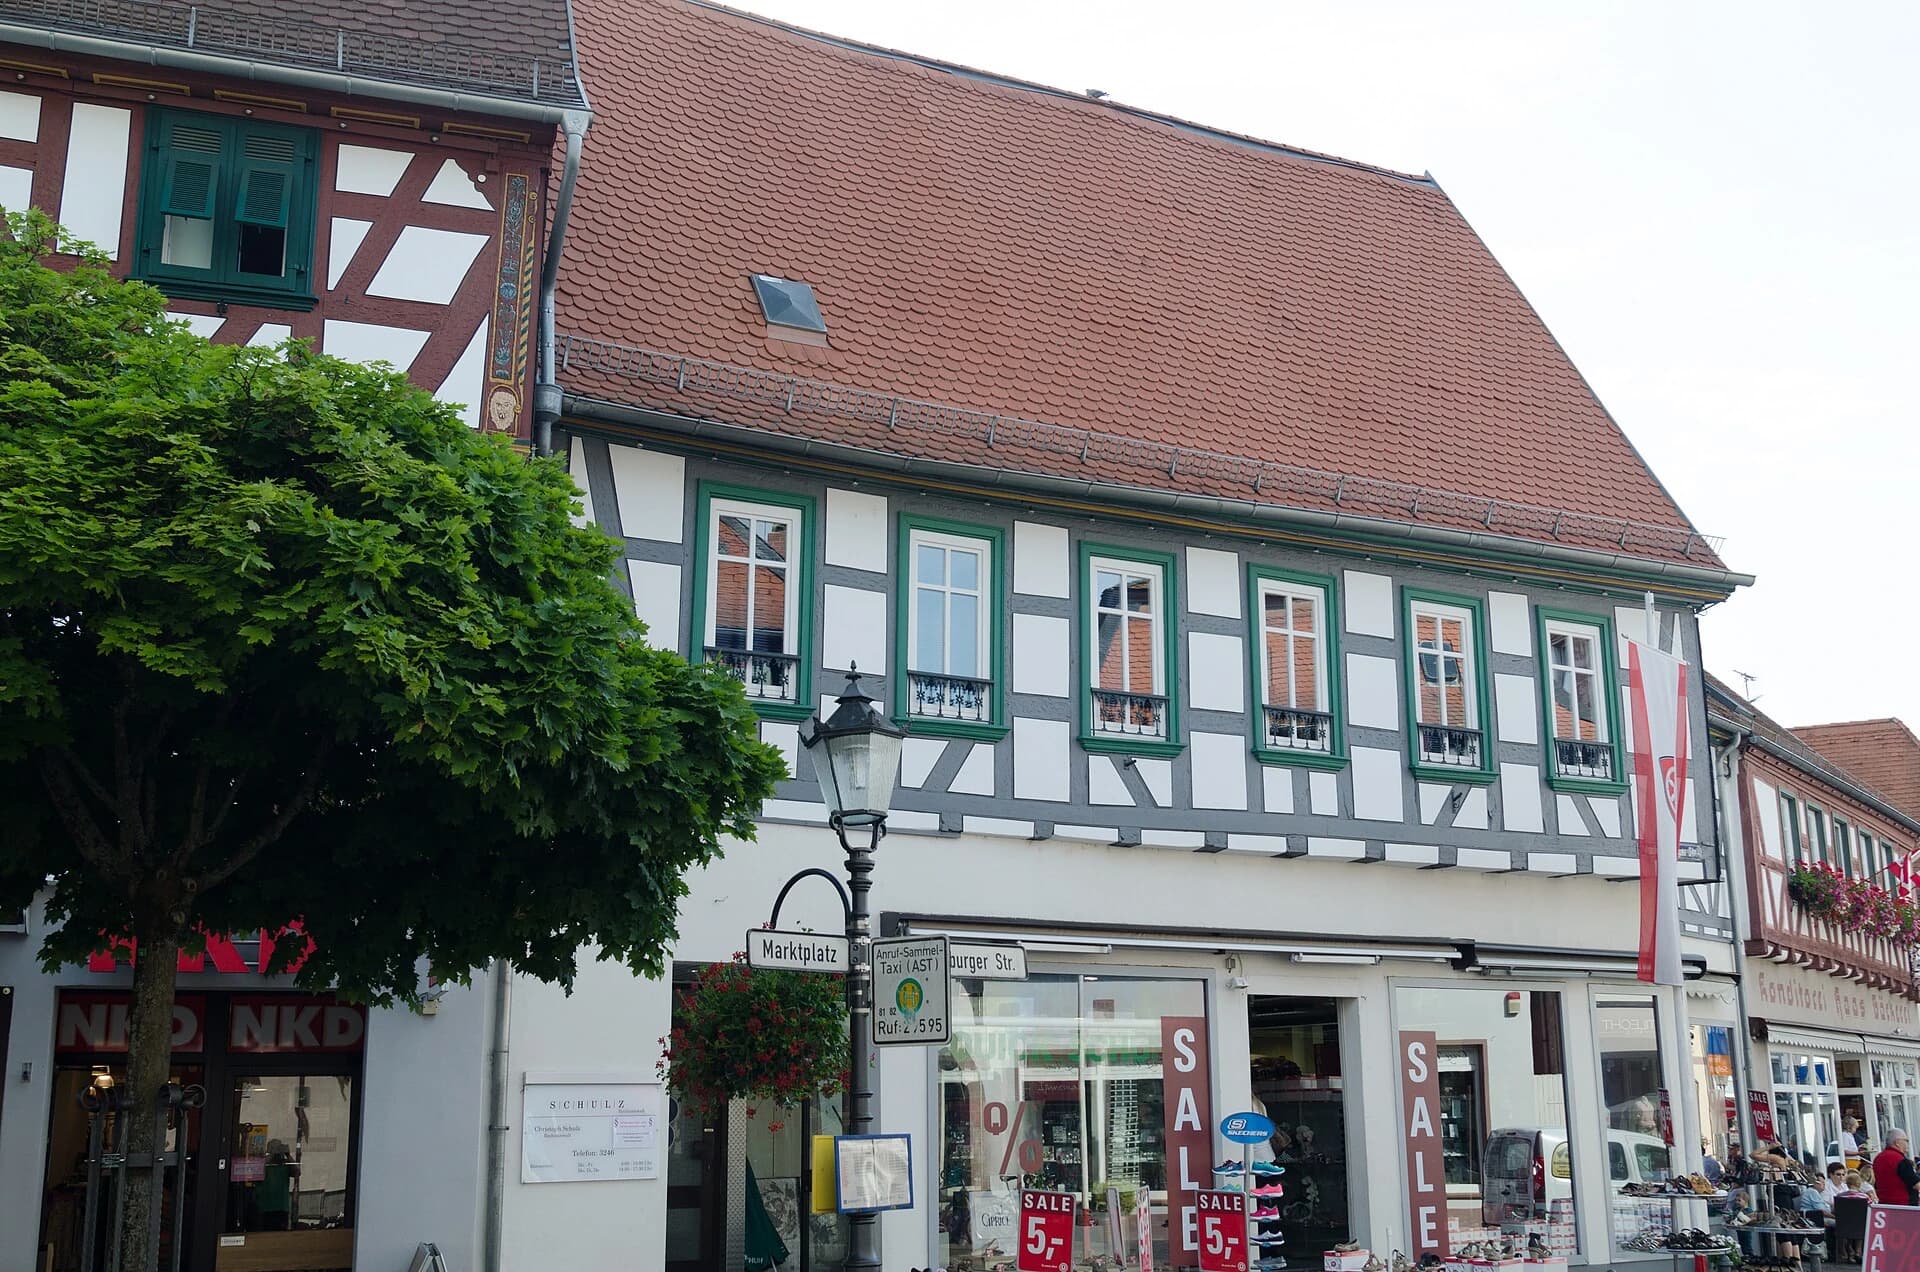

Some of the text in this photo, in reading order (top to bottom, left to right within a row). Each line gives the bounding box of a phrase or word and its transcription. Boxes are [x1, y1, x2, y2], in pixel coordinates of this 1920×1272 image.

[762, 939, 837, 965] Marktplatz
[876, 944, 943, 960] Anruf-Sammel-
[880, 958, 938, 974] Taxi (AST)
[995, 953, 1016, 970] Str.
[879, 1006, 897, 1016] 81 82
[230, 1004, 363, 1047] NKD
[1748, 1092, 1768, 1104] SALE
[1173, 1028, 1202, 1251] SALE
[1407, 1041, 1439, 1248] SALE
[1024, 1194, 1070, 1211] SALE
[1200, 1194, 1242, 1211] SALE
[1027, 1216, 1064, 1260] 5,-
[1205, 1217, 1239, 1260] 5,-
